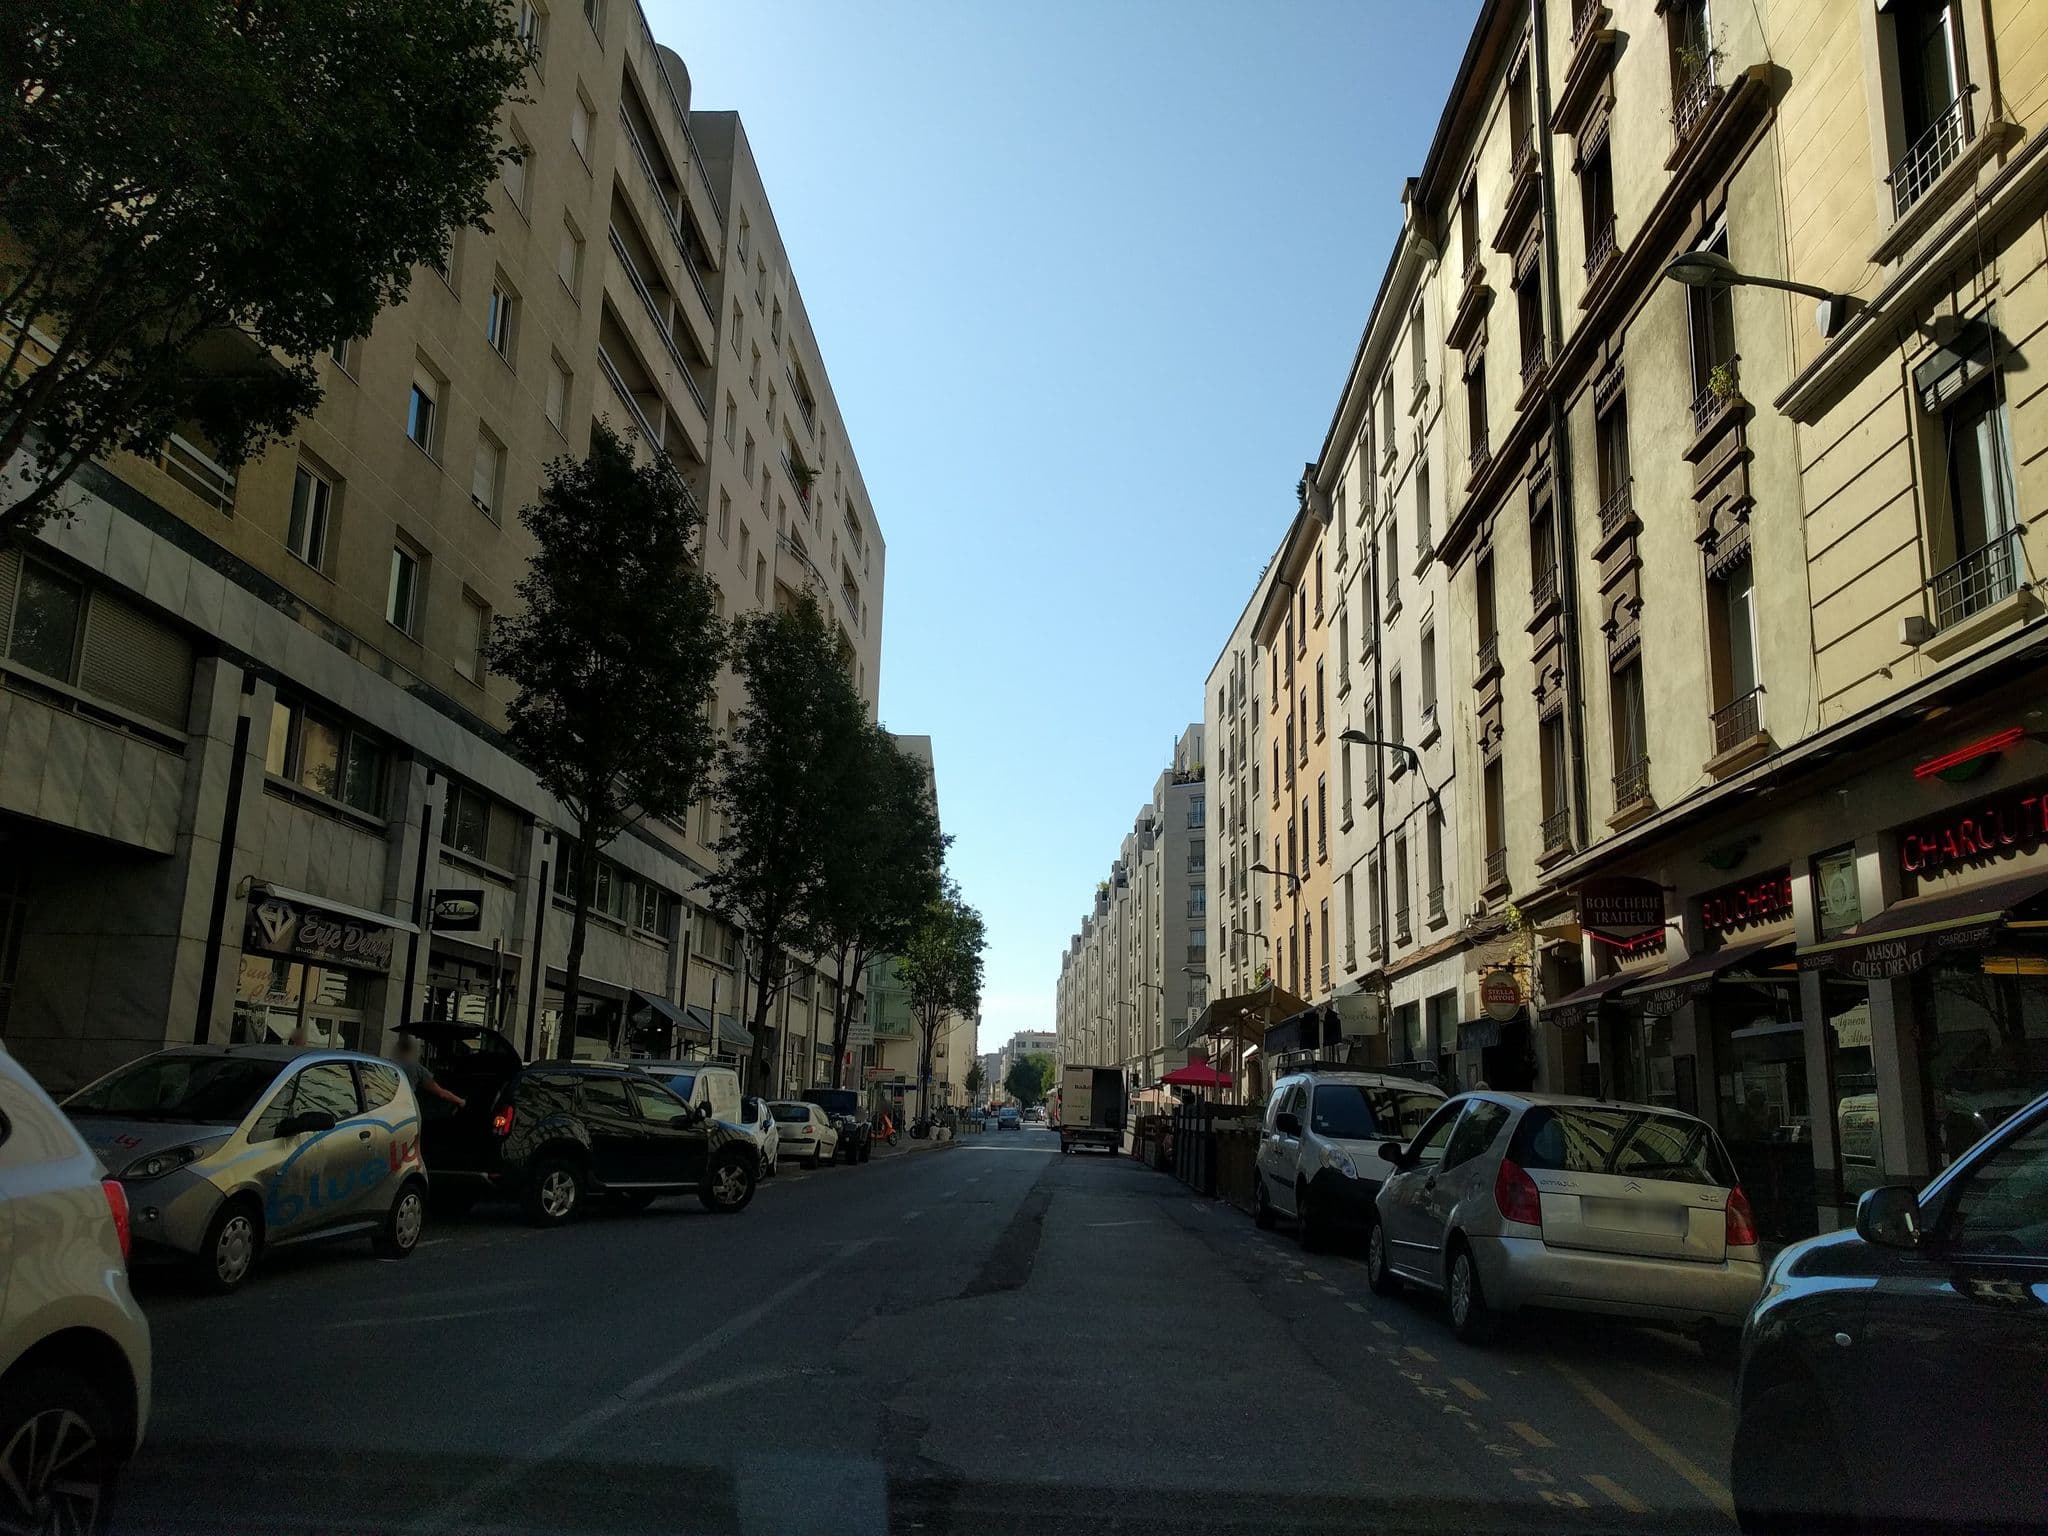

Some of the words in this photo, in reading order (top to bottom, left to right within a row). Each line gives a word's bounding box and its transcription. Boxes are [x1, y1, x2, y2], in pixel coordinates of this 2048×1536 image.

[1586, 896, 1660, 909] BOUCHERIE
[1703, 876, 1793, 929] BOUCHERIE
[1594, 911, 1654, 924] TRAITEUR
[1937, 927, 1990, 947] CHARCUTERIE
[1865, 941, 1909, 962] MAISON
[1852, 959, 1883, 979] GILLES
[1885, 948, 1925, 976] DREVET
